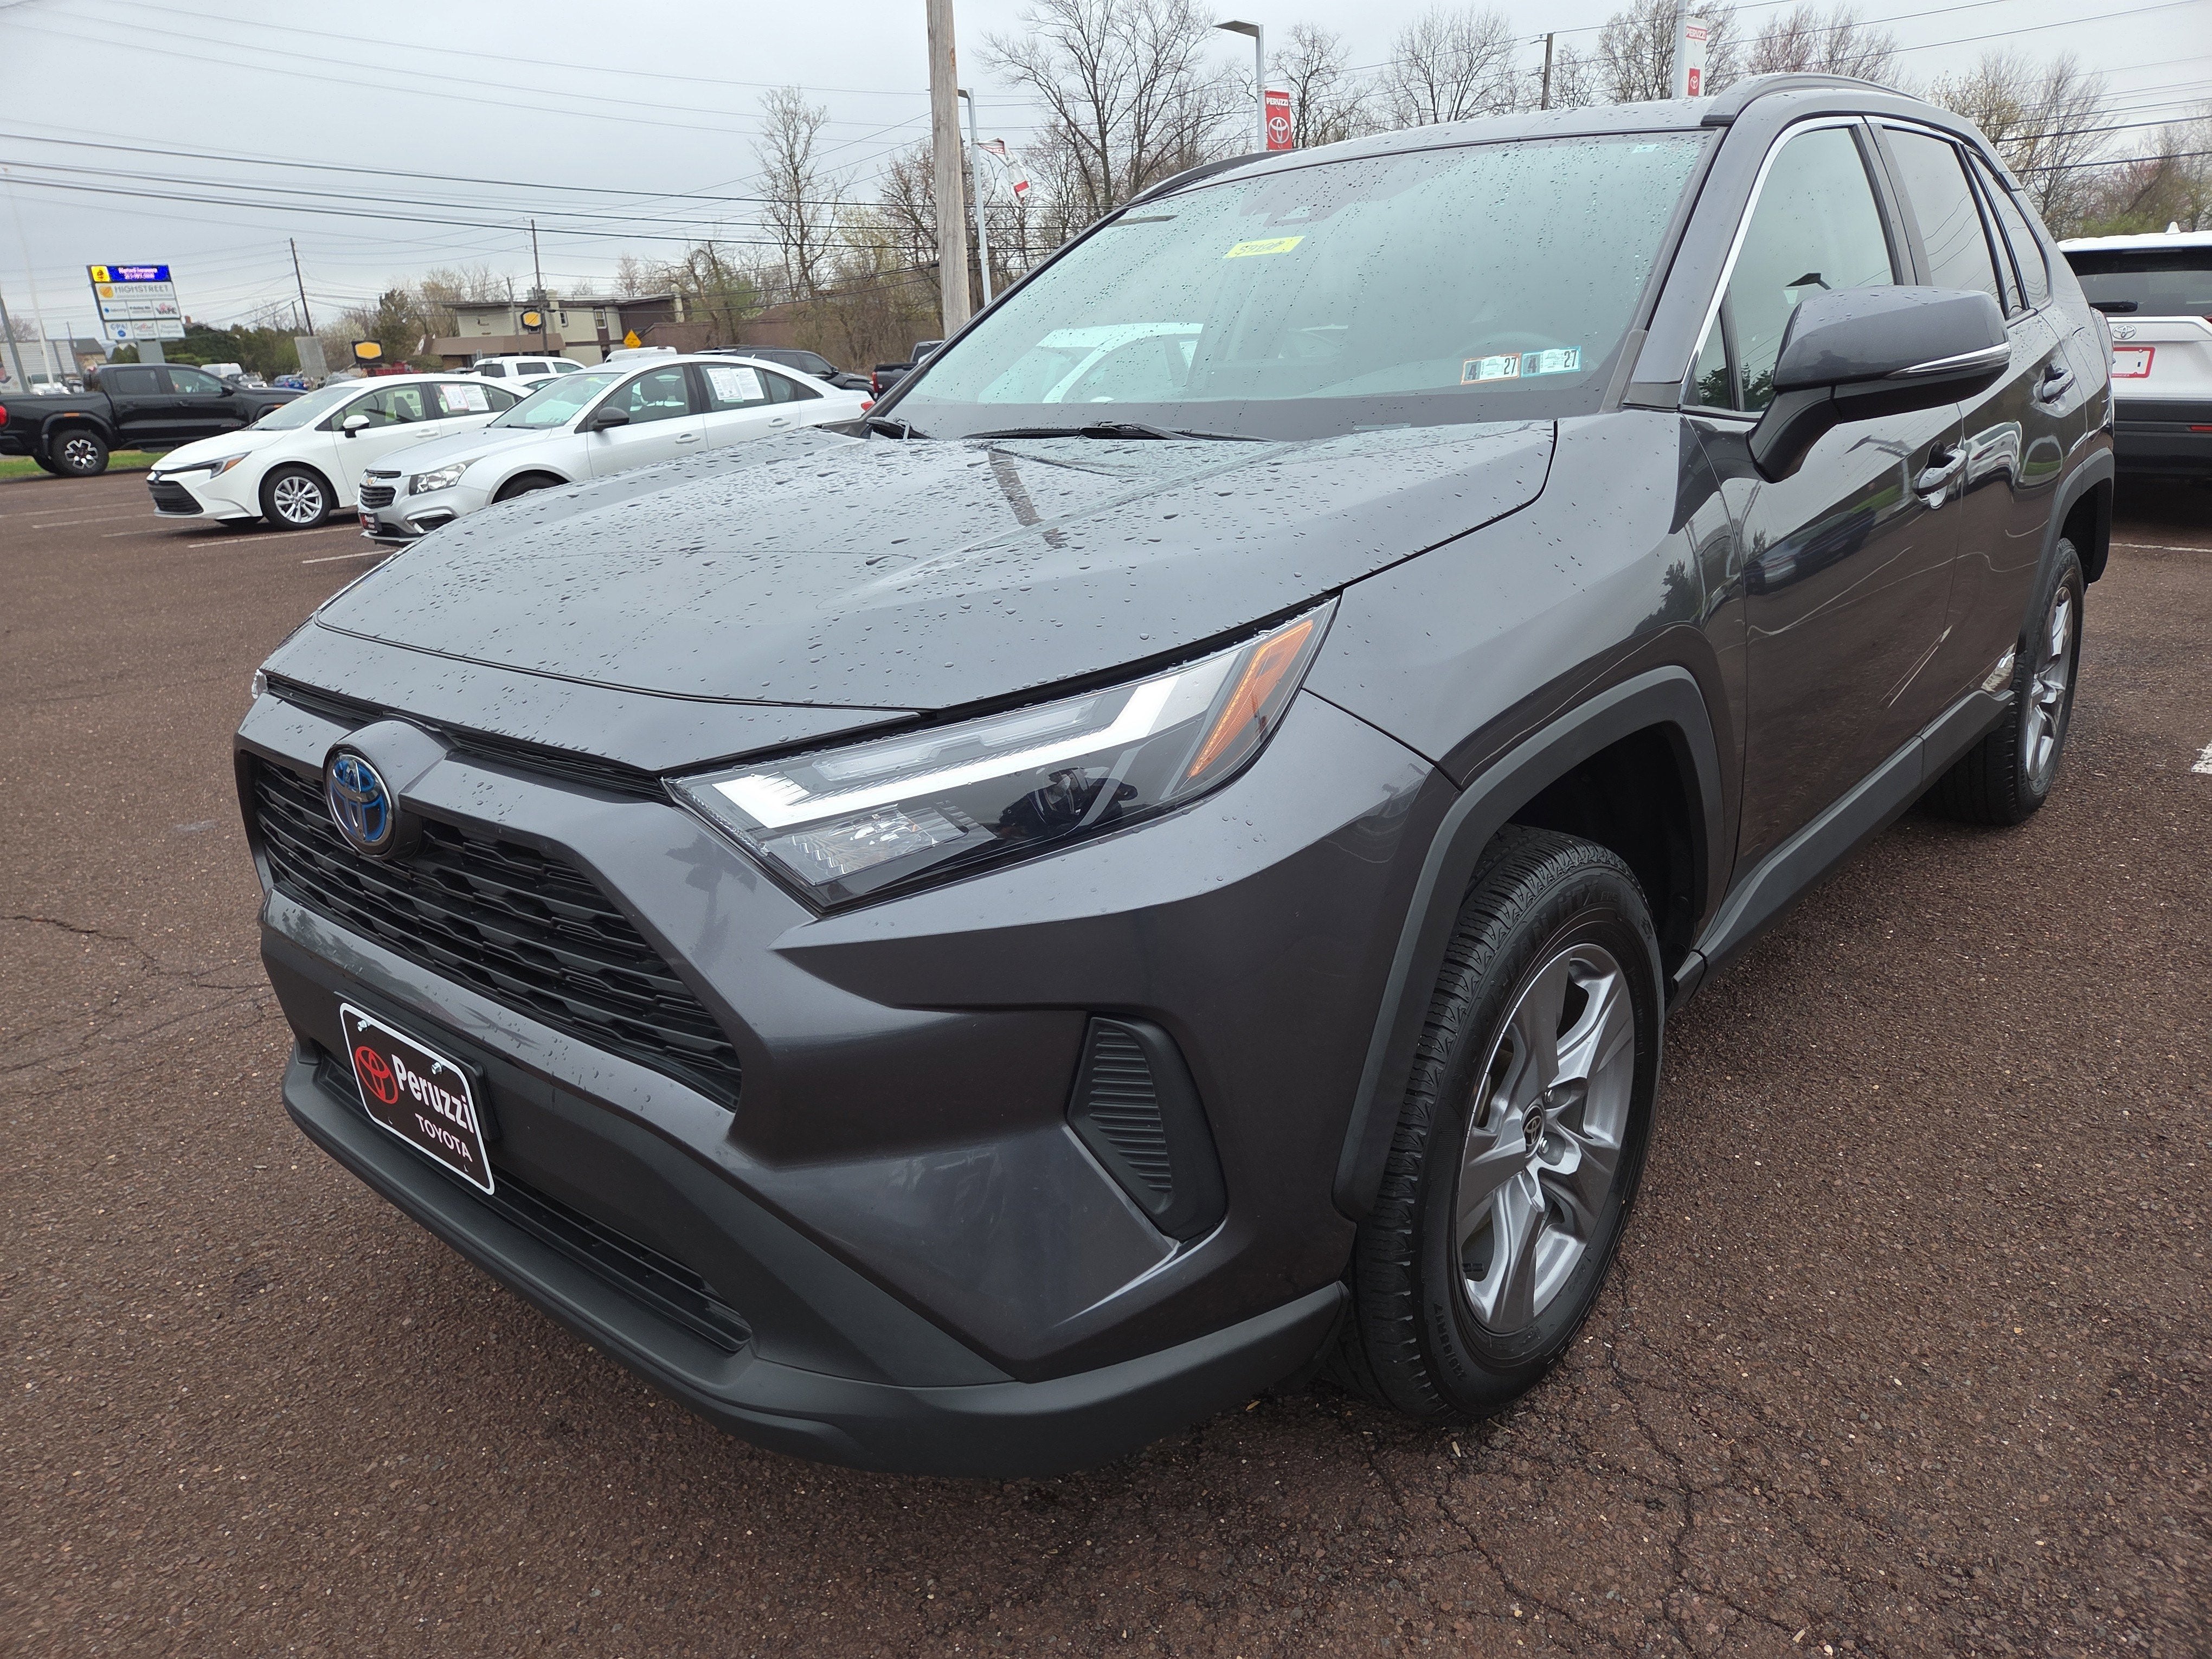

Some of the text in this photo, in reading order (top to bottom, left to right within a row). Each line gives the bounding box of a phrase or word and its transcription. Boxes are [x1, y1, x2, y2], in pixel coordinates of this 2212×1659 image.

[114, 284, 169, 293] HIGHSTREET
[1469, 364, 1477, 380] 4
[1504, 357, 1517, 375] 27
[1528, 357, 1537, 374] 4
[1564, 350, 1577, 368] 27
[391, 1054, 474, 1134] Peruzzi
[415, 1113, 473, 1162] TOYOTA
